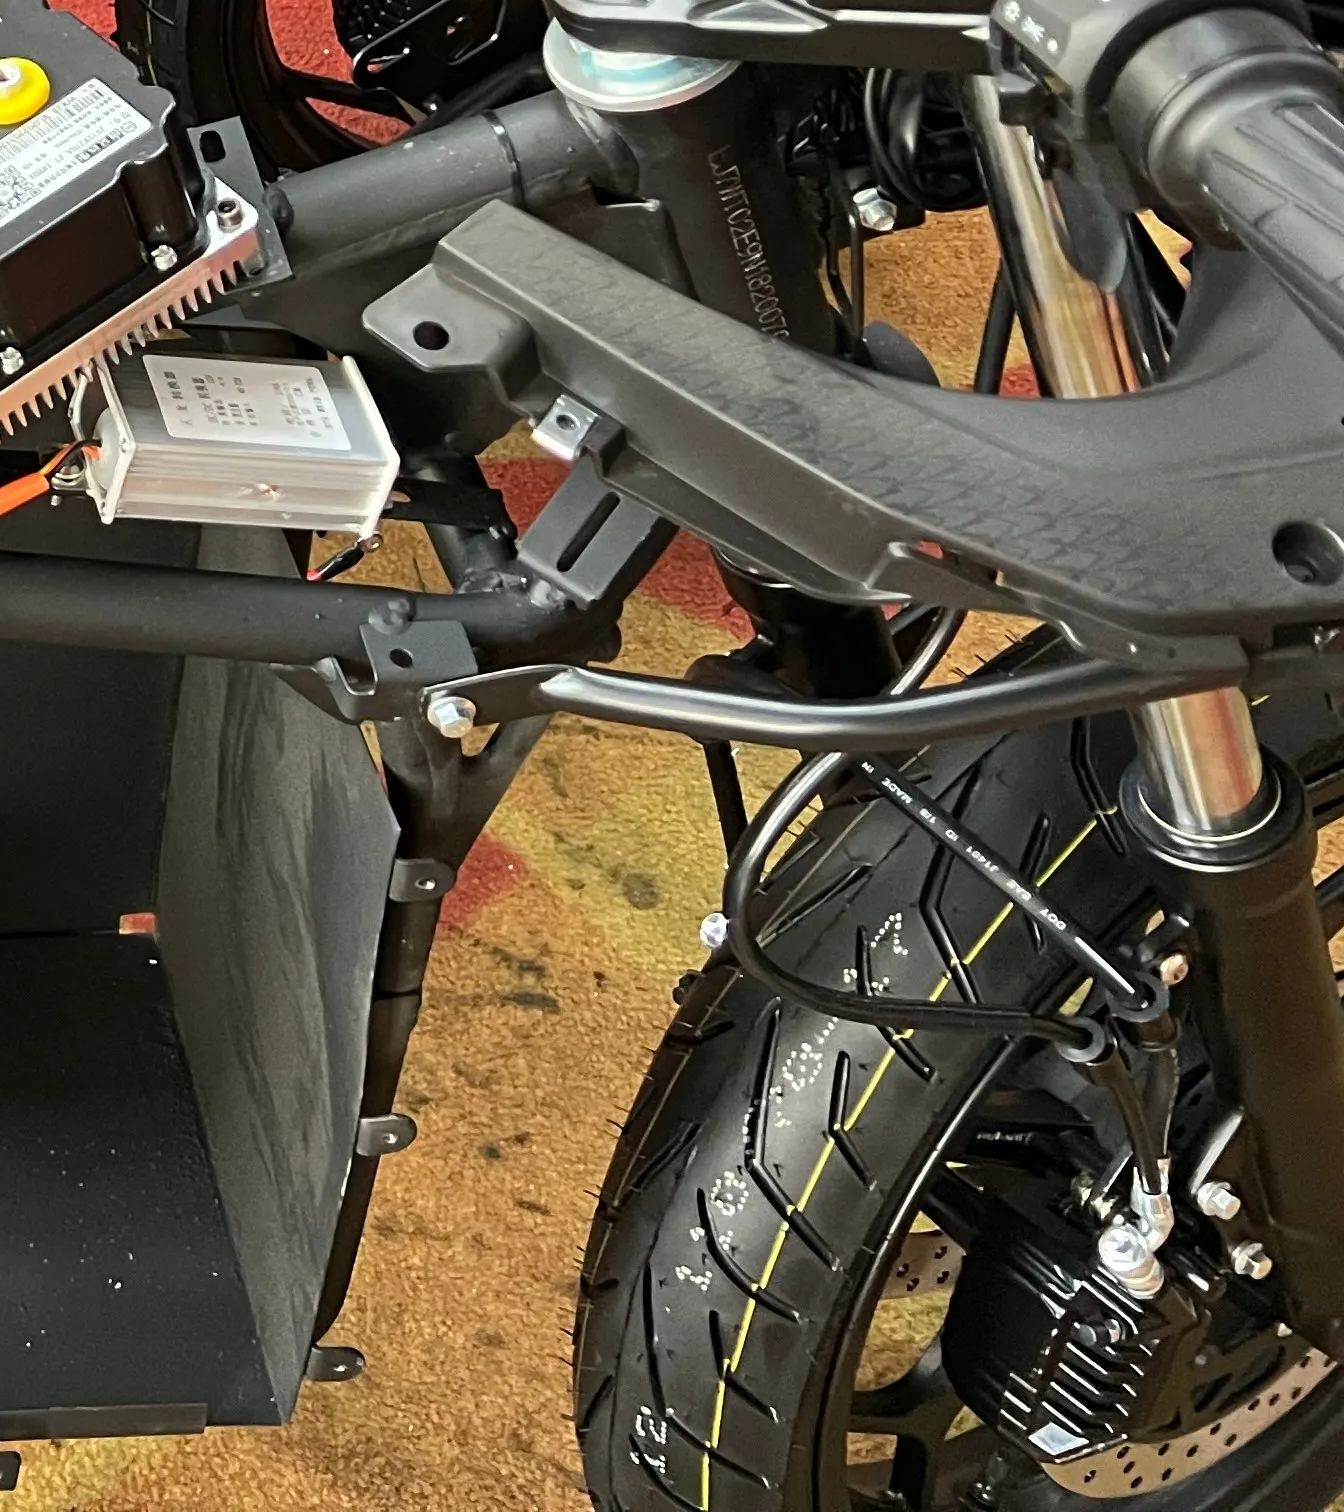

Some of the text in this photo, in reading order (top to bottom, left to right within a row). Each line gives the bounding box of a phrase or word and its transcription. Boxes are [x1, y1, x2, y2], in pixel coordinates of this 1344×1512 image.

[861, 760, 875, 774] IN
[881, 776, 913, 805] MADE
[944, 828, 960, 842] ID
[1004, 878, 1033, 901] SAE
[1039, 907, 1067, 931] DOT
